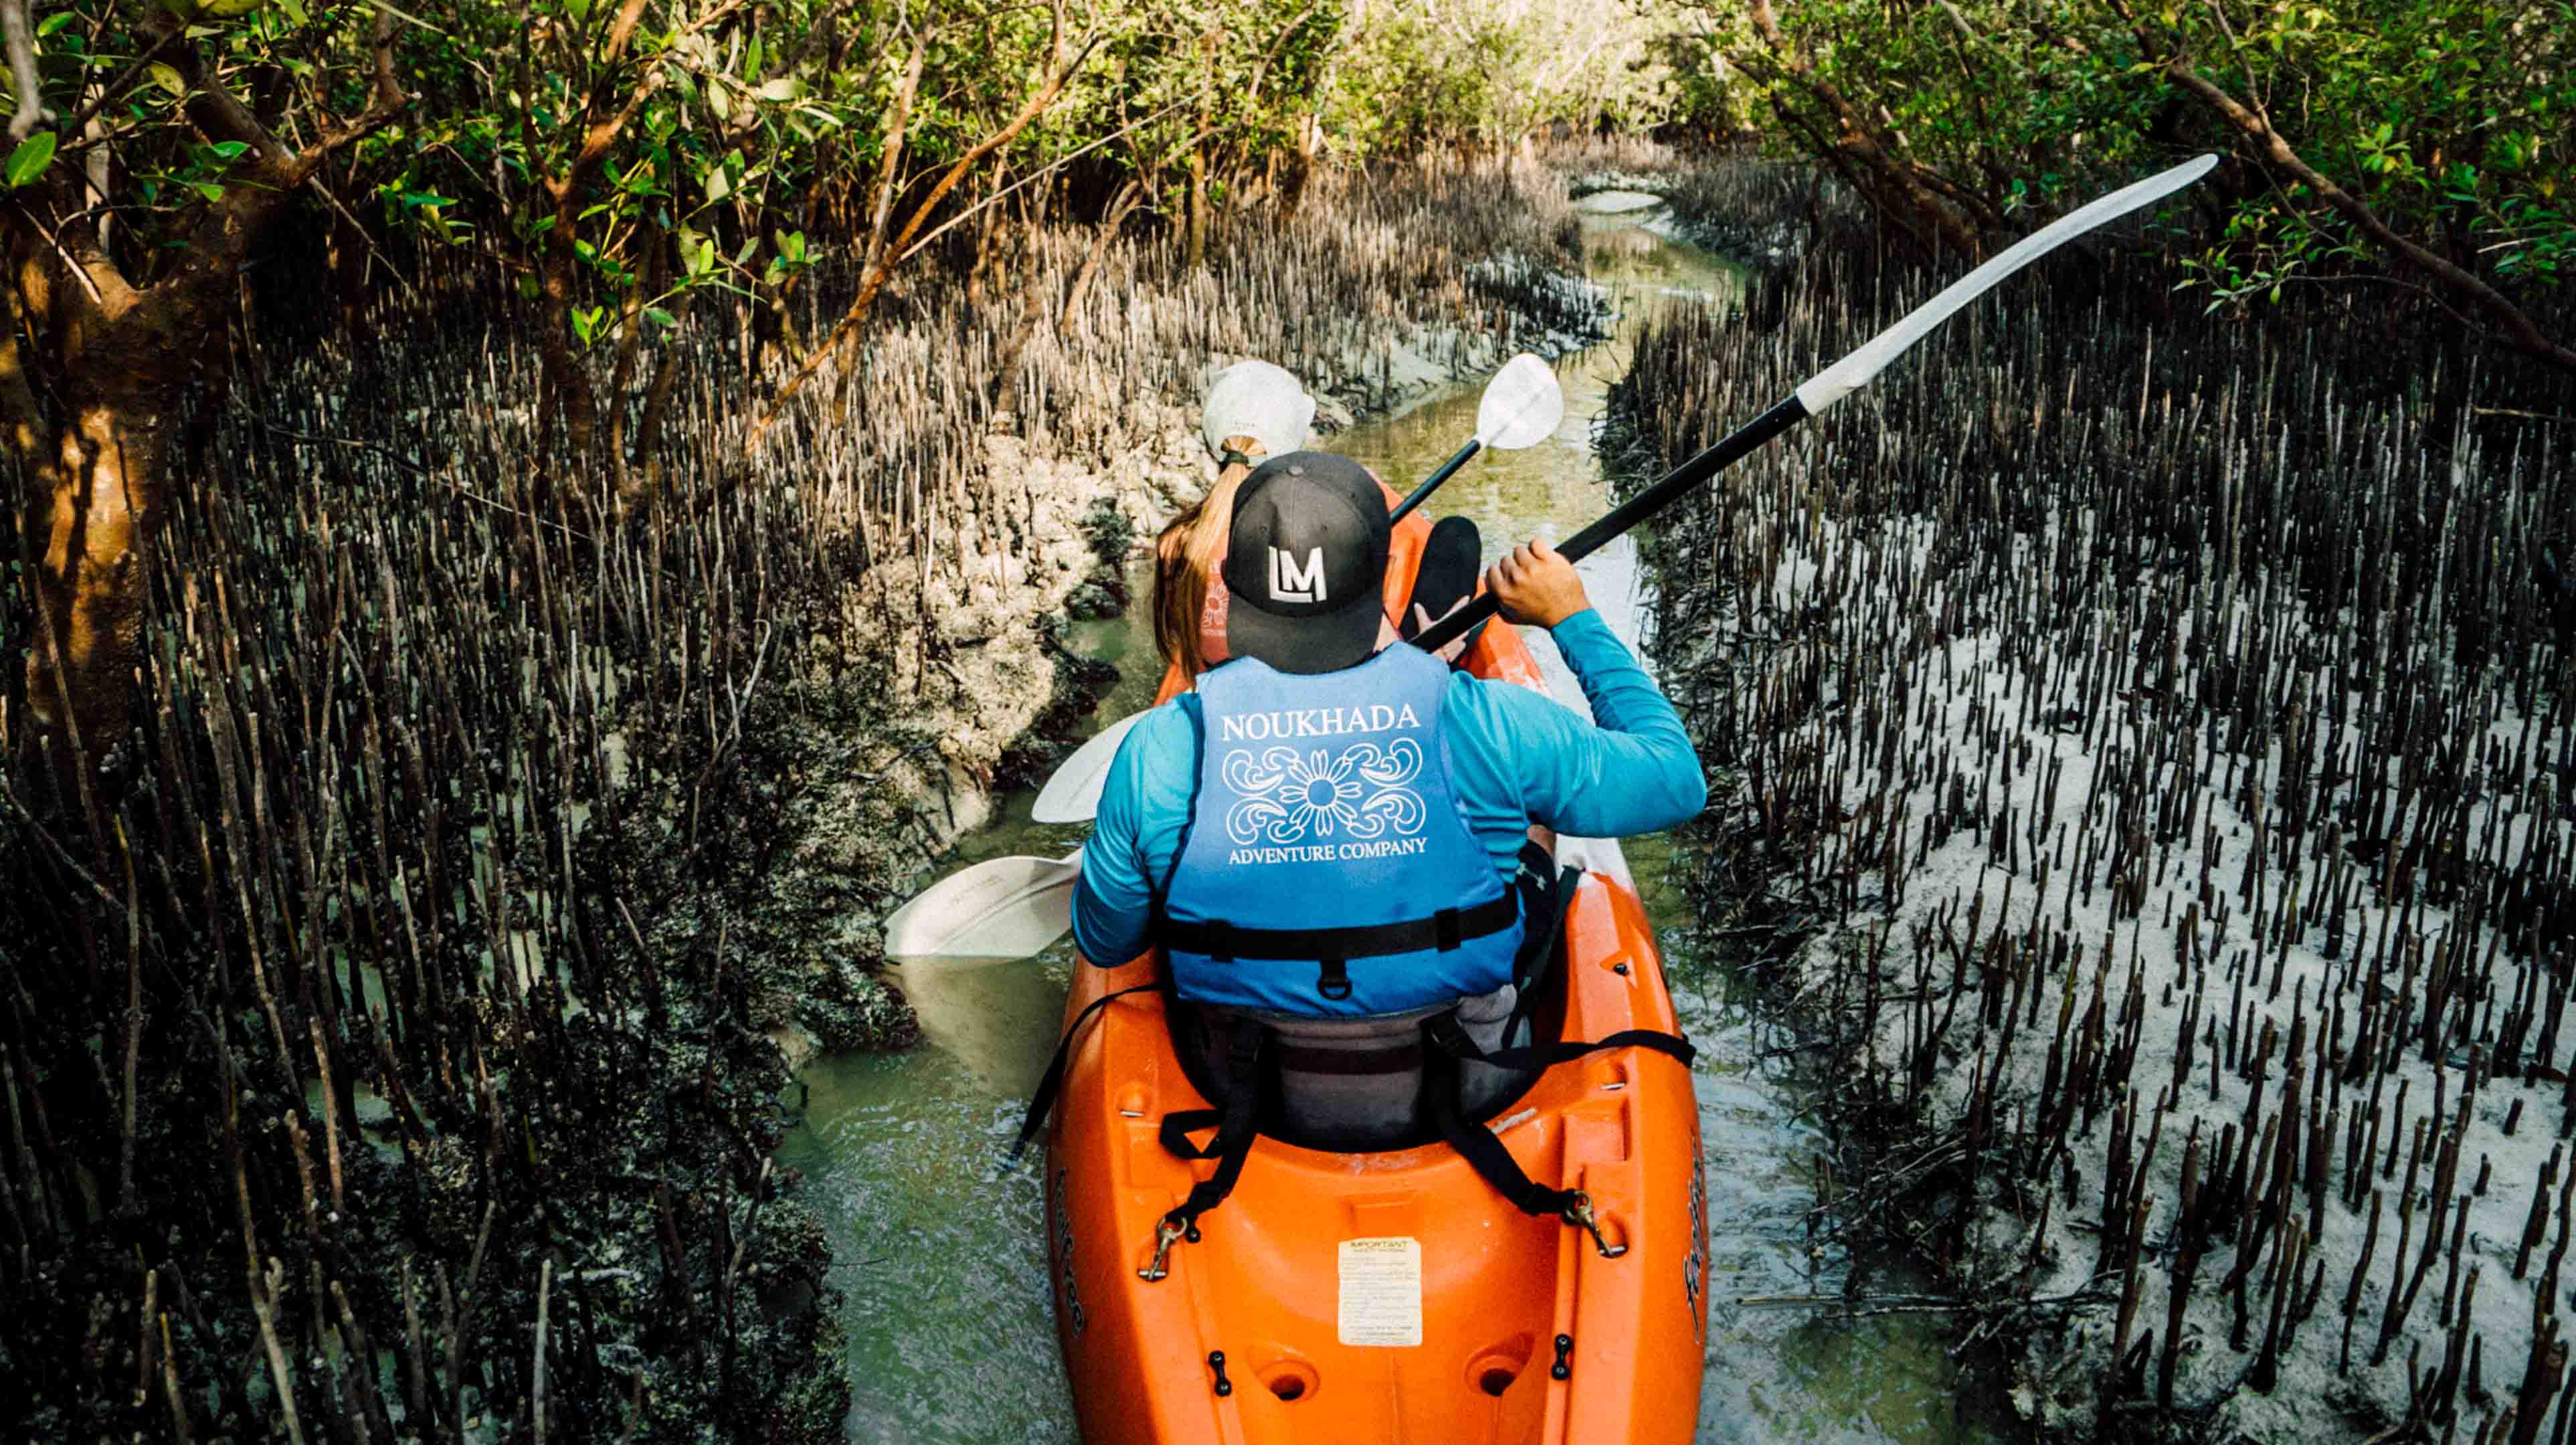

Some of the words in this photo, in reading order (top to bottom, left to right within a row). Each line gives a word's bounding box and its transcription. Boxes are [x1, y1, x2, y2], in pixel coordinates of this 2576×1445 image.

[1269, 545, 1327, 603] LM
[1221, 703, 1420, 741] NOUKHADA
[1229, 845, 1335, 865] ADVENTURE
[1339, 838, 1428, 859] COMPANY
